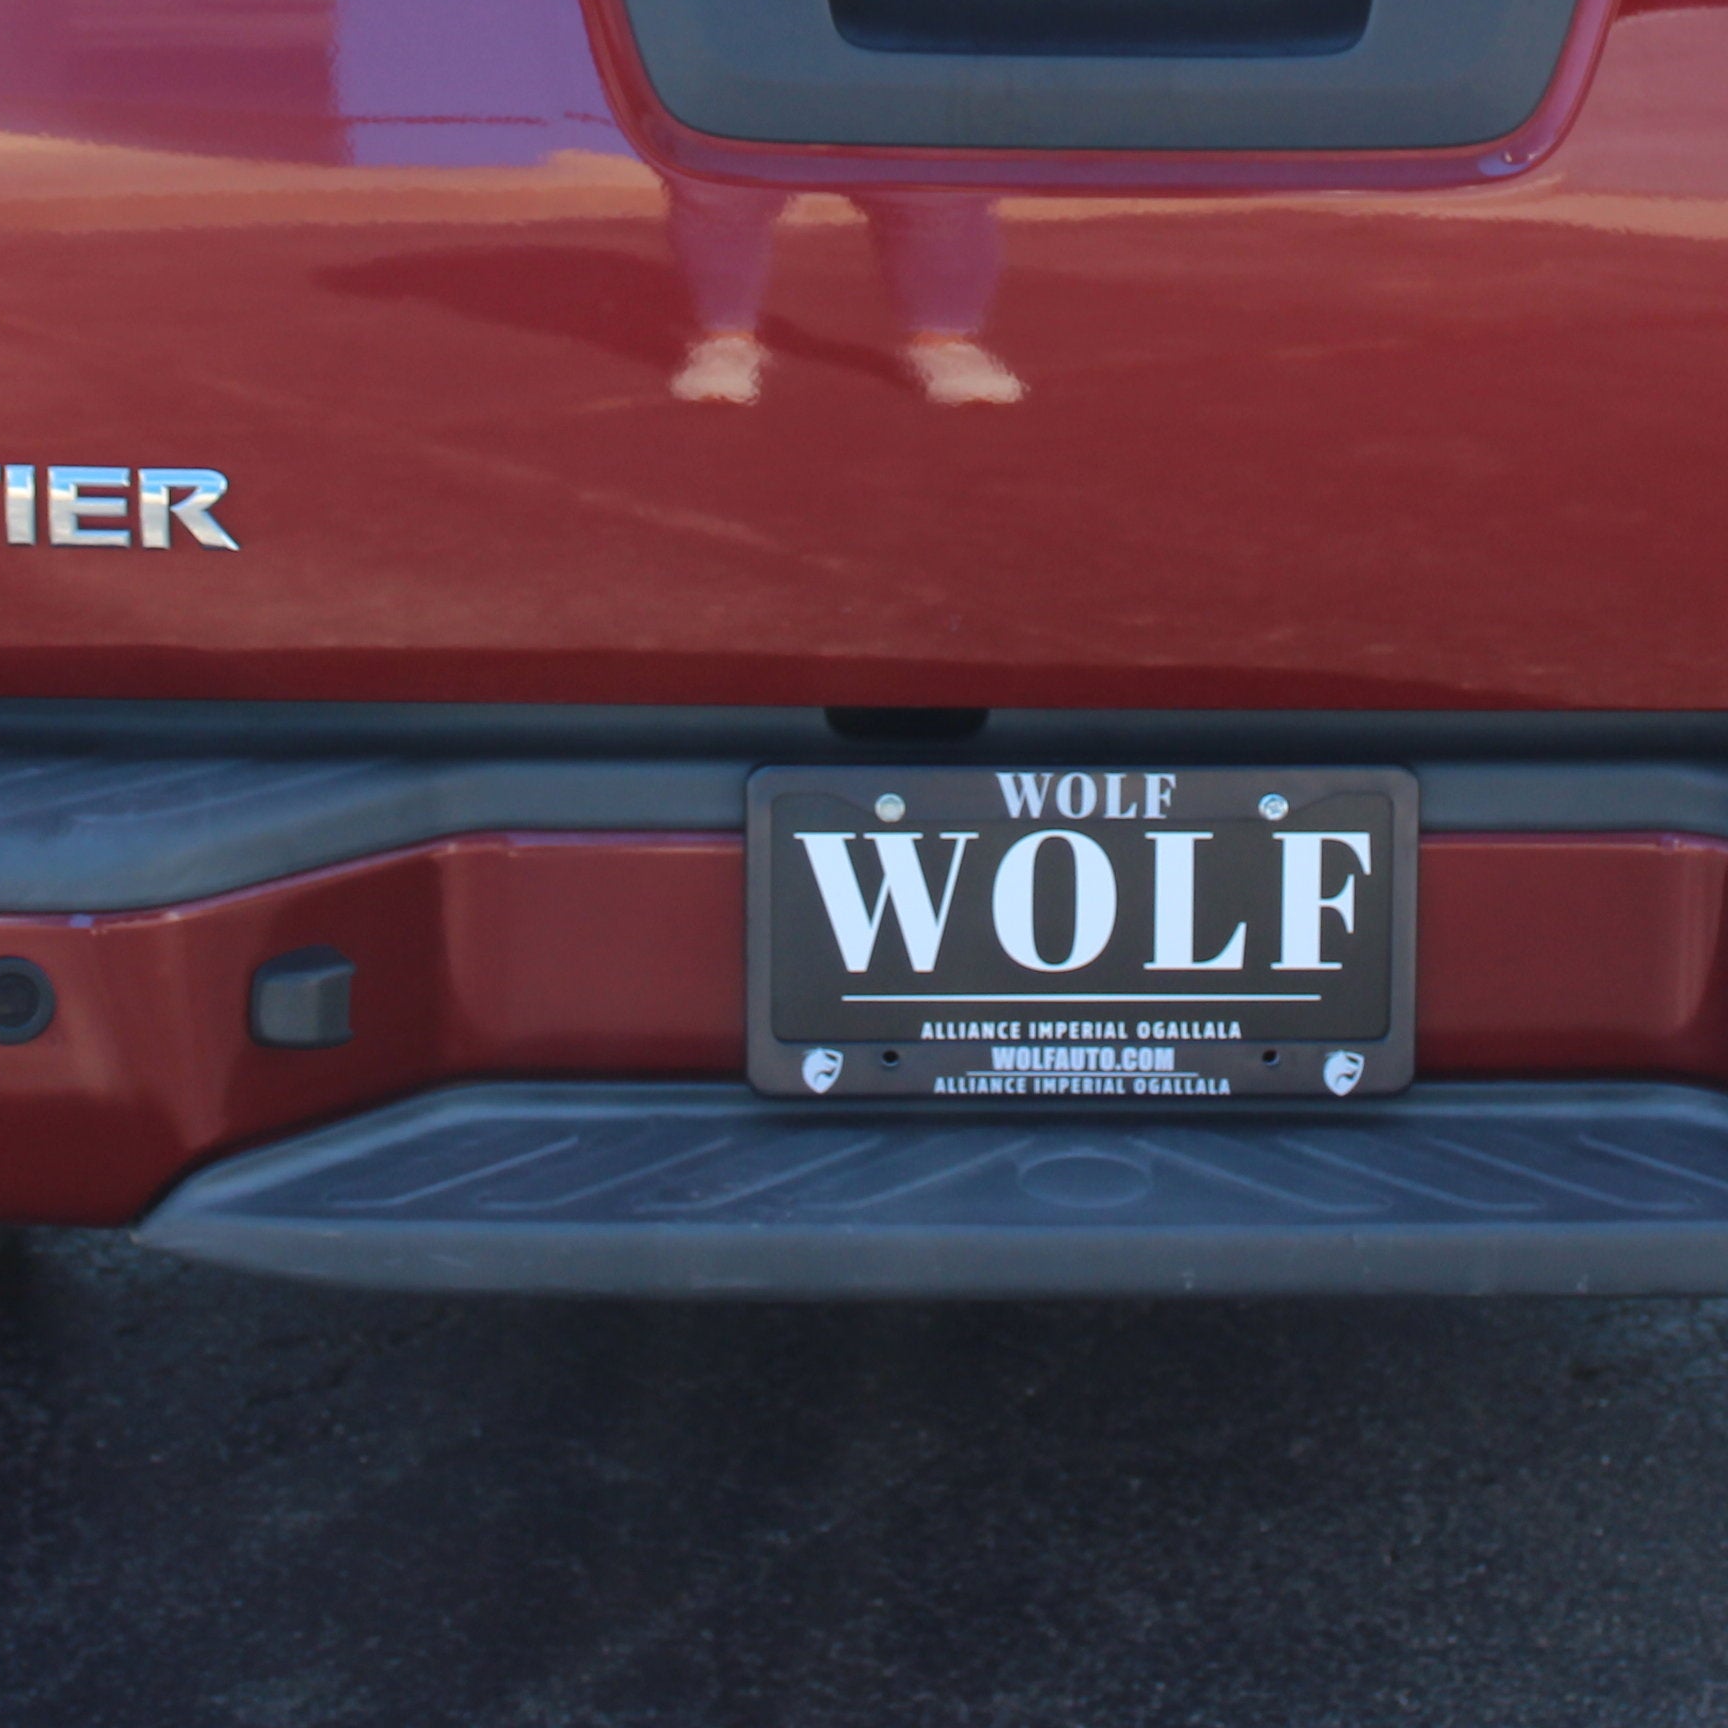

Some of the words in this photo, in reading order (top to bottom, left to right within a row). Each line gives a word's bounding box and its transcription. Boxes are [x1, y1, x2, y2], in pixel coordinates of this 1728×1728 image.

[995, 771, 1177, 820] WOLF
[793, 828, 1372, 973] WOLF
[921, 1022, 1021, 1040] ALLIANCE
[1028, 1022, 1128, 1040] IMPERIAL
[1136, 1022, 1242, 1040] OGALLALA
[991, 1046, 1175, 1071] WOLFAUTO.COM
[933, 1076, 1027, 1094] ALLIANCE
[1033, 1077, 1126, 1095] IMPERIAL
[1133, 1077, 1231, 1096] OGALLALA
